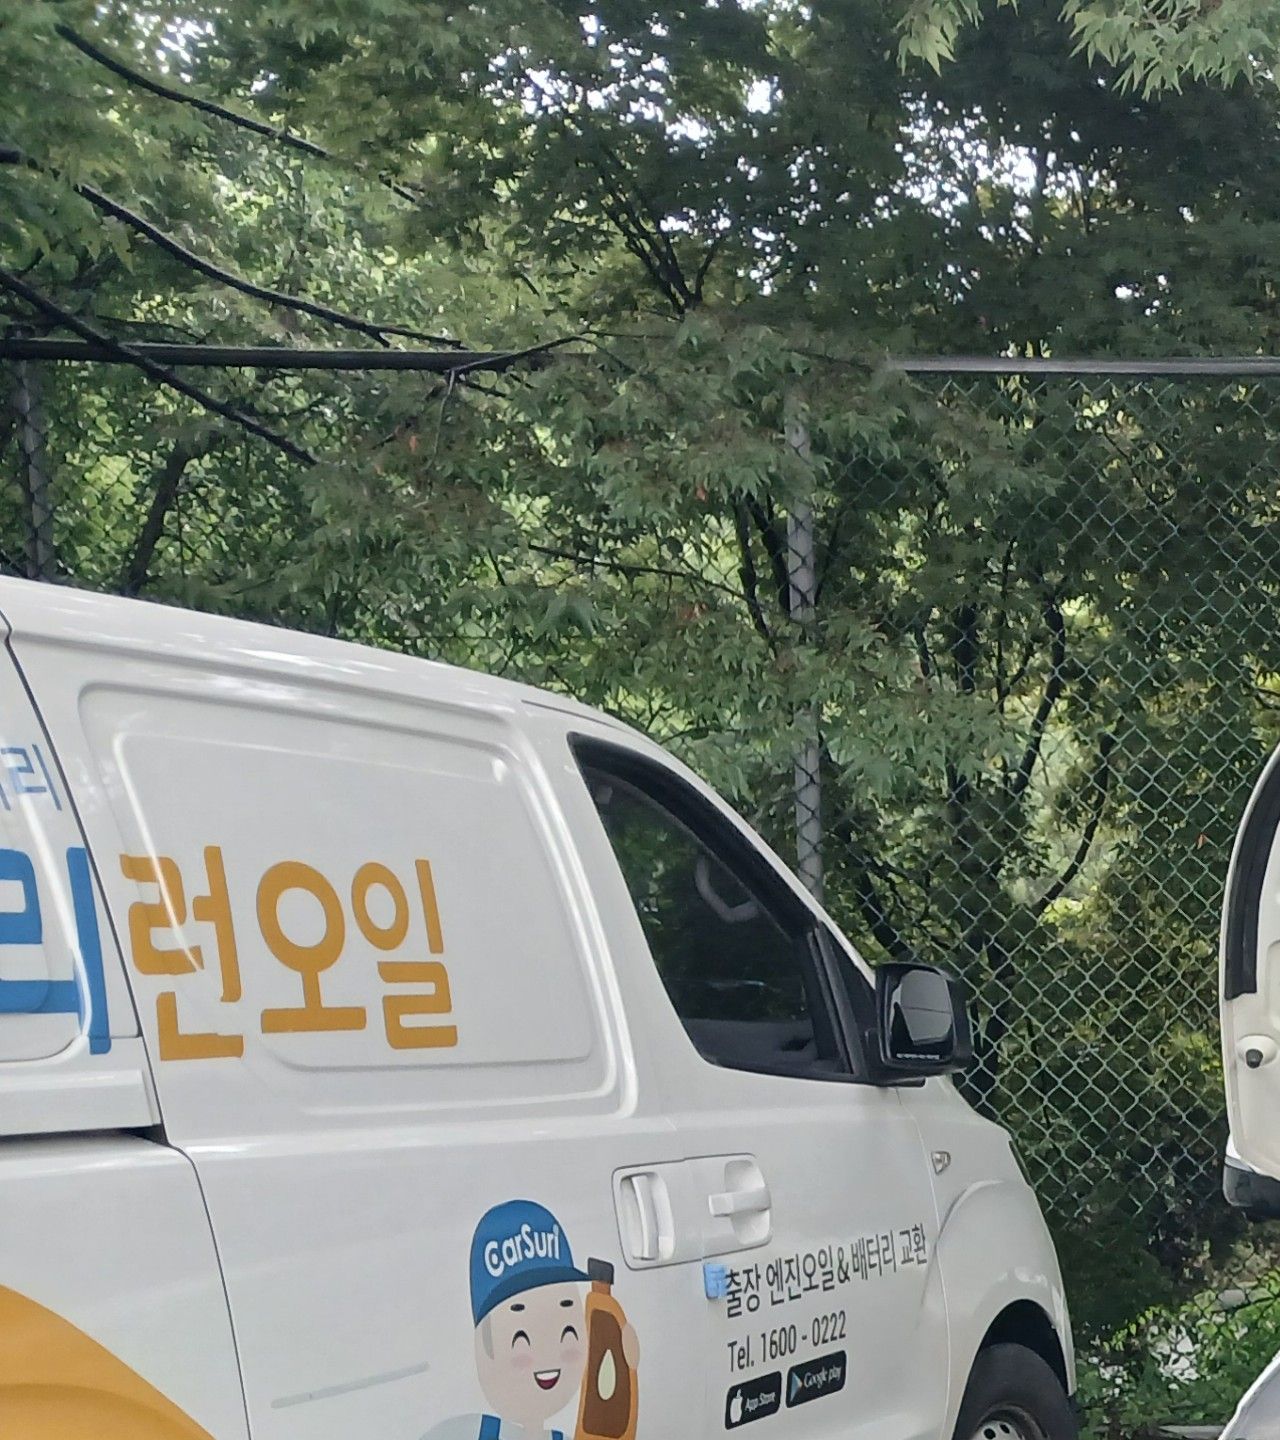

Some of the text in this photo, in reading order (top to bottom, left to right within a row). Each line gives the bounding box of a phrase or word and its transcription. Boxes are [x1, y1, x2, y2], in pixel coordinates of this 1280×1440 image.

[0, 743, 62, 811] 리
[484, 1223, 560, 1277] CarSuri
[724, 1263, 761, 1318] 출장
[899, 1223, 928, 1265] 교환
[727, 1334, 755, 1372] Tel.
